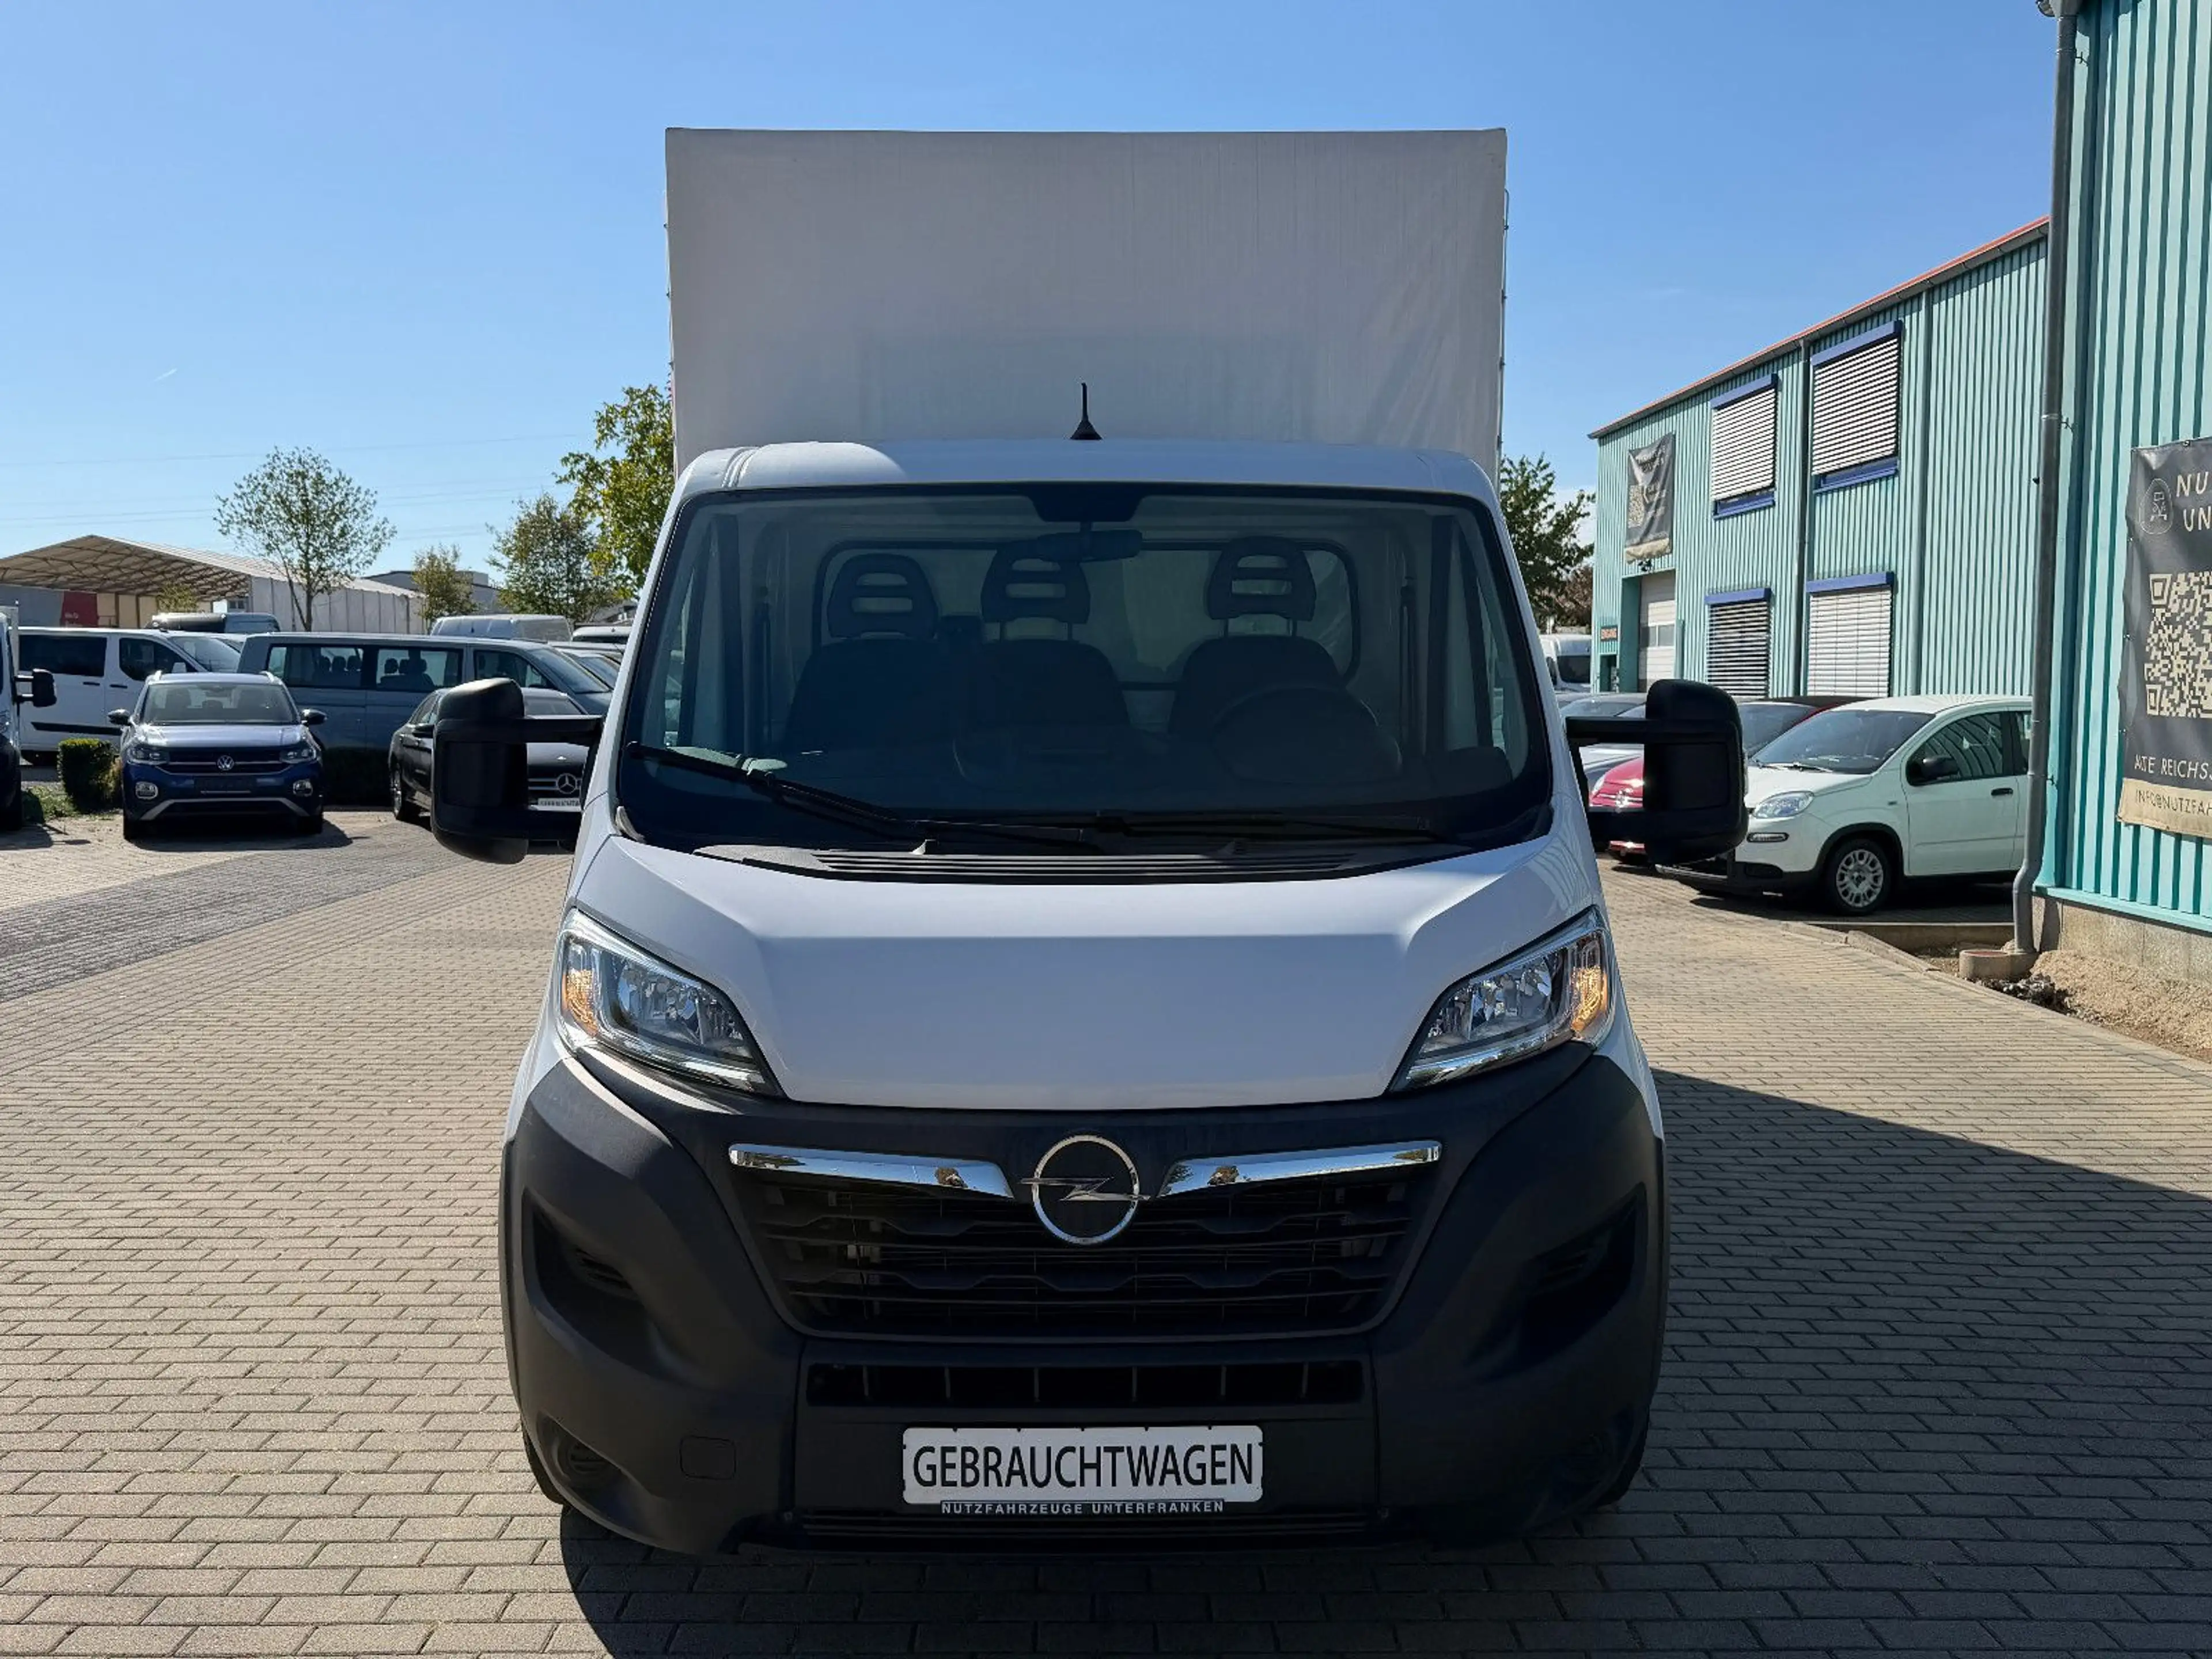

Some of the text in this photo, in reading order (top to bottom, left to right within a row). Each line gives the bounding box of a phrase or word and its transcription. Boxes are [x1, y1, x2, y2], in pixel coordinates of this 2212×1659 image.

[2161, 757, 2212, 781] REICHS
[913, 1443, 1252, 1488] GEBRAUCHTWAGEN
[941, 1501, 1224, 1514] NUTZFAHRZEUGE UNTERFRANKEN
